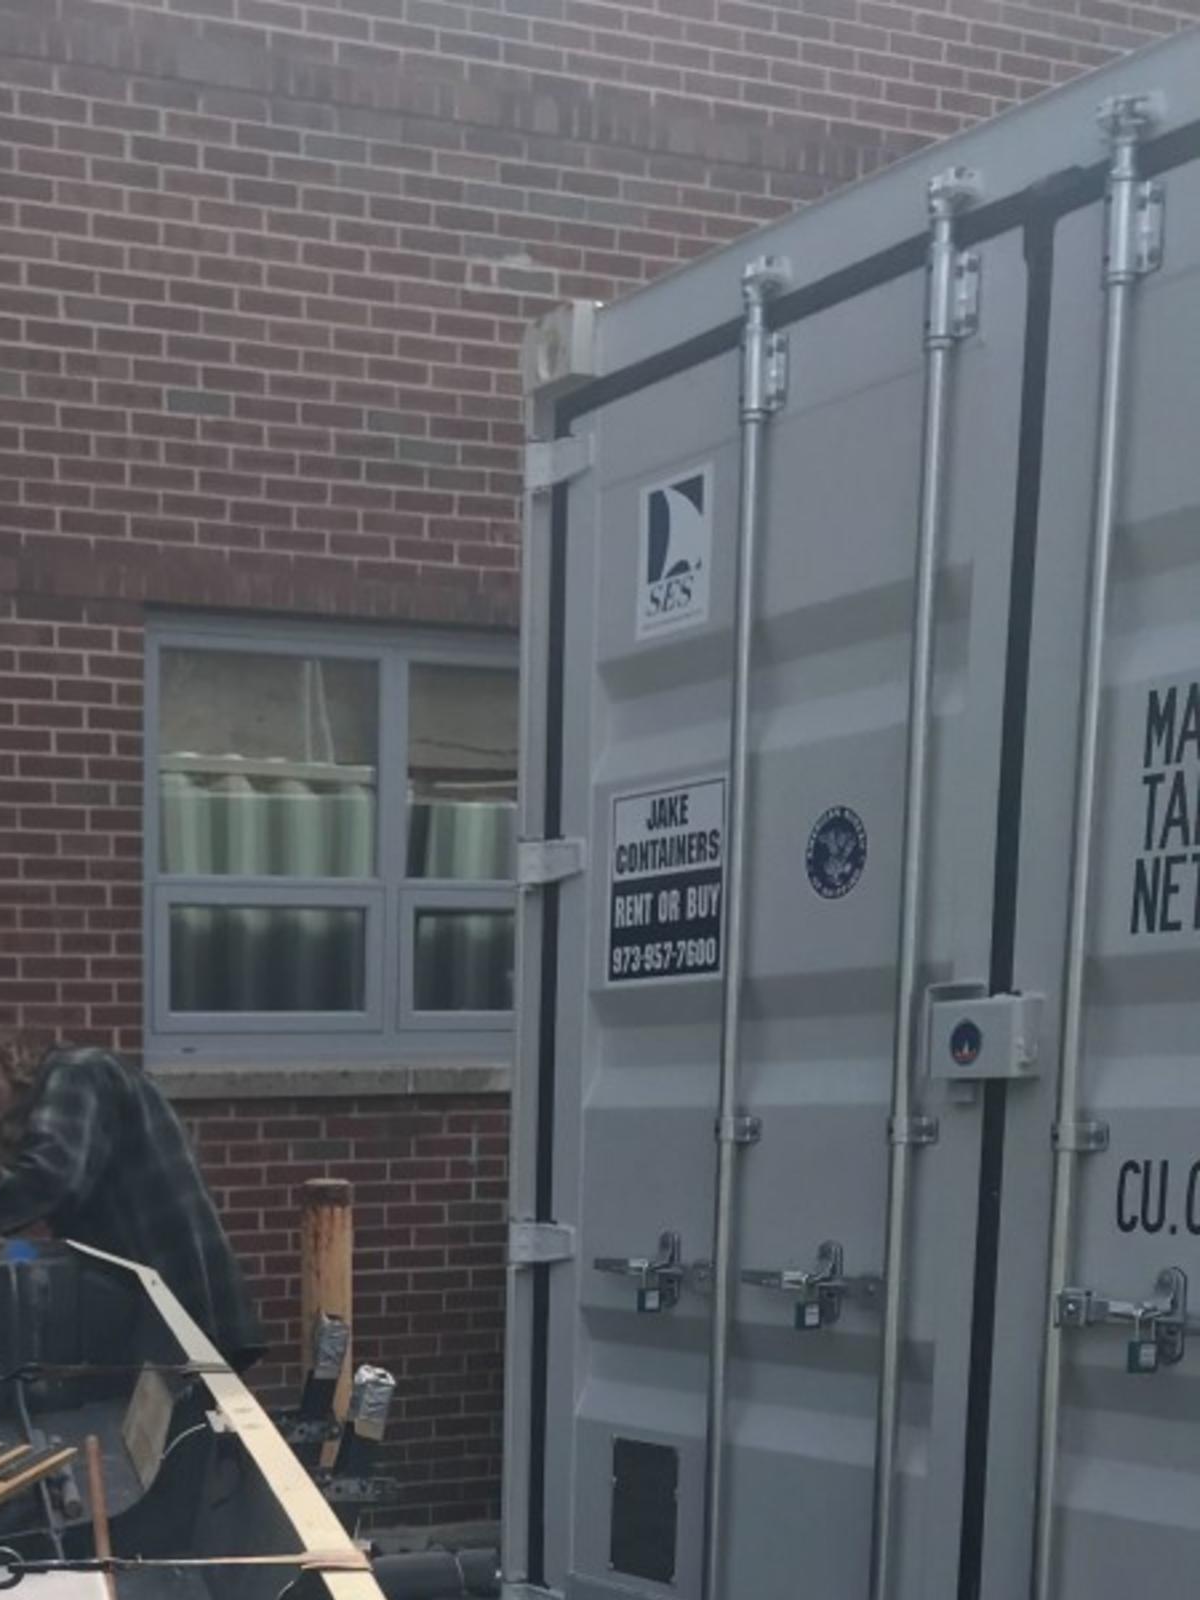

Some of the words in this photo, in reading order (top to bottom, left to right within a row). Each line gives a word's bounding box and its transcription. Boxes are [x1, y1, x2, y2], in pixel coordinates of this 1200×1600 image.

[646, 575, 694, 617] SES
[646, 794, 689, 831] JAKE
[1142, 770, 1200, 852] TA
[615, 829, 720, 875] CONTAINERS
[614, 893, 653, 928] RENT
[658, 889, 681, 924] OR
[686, 882, 720, 921] BUY
[612, 937, 716, 974] 973-957-7600
